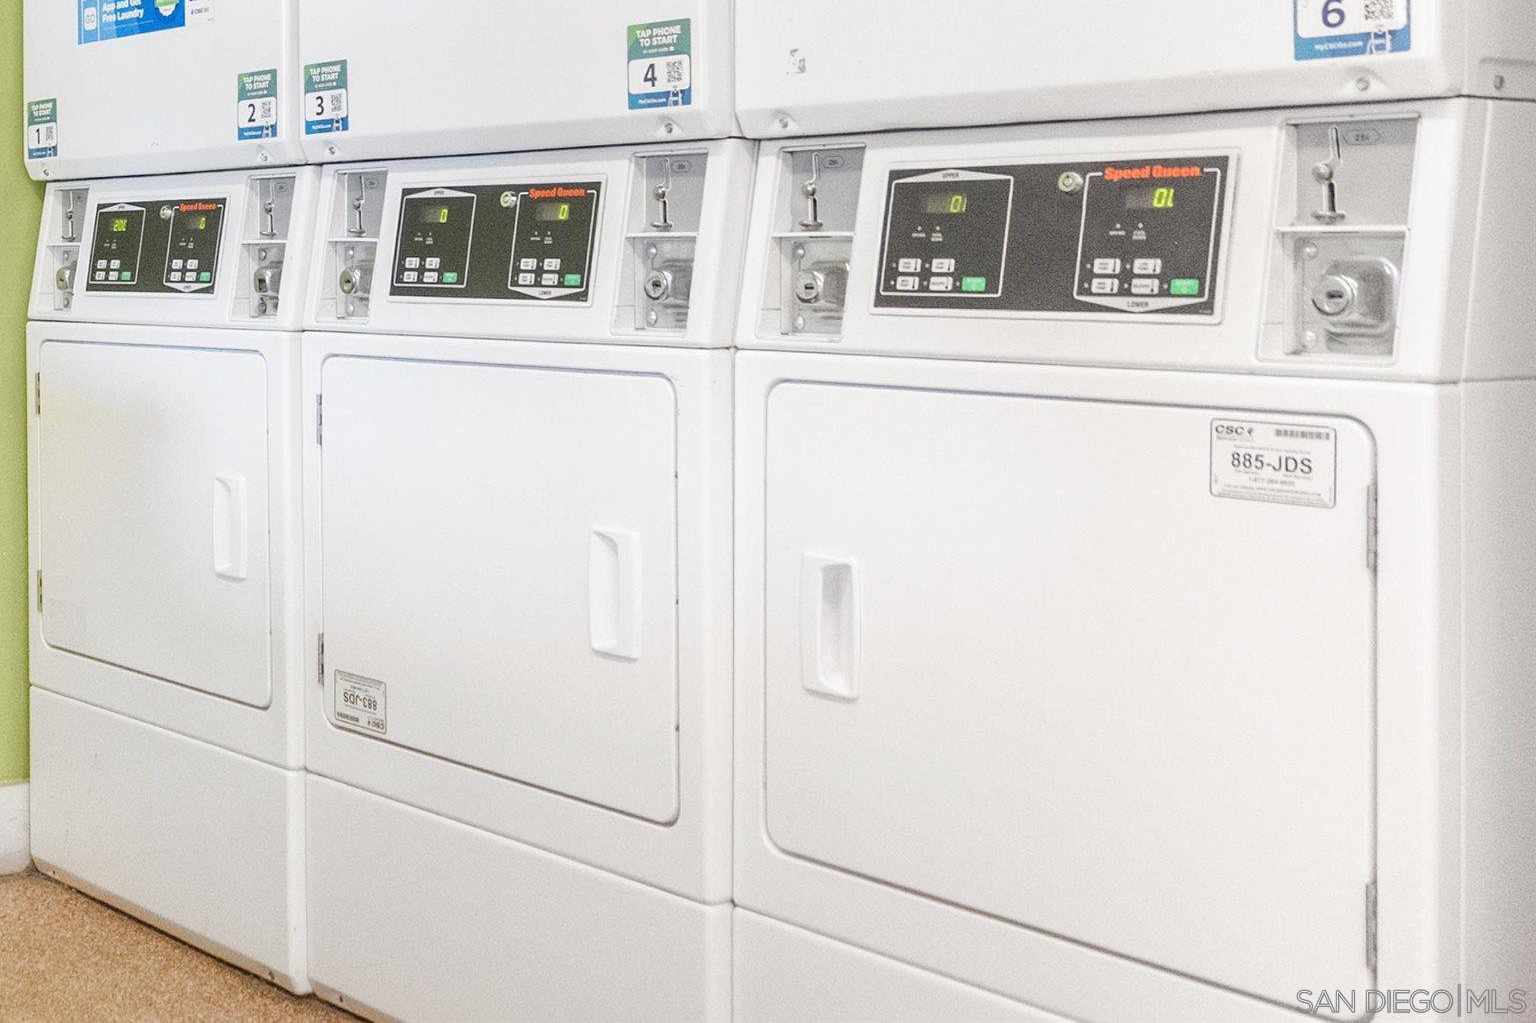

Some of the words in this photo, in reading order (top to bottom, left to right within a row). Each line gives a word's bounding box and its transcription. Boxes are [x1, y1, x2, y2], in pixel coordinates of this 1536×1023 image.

[103, 2, 116, 12] App
[117, 8, 144, 20] Laundry
[636, 29, 652, 38] TAP
[652, 25, 682, 37] PHONE
[639, 38, 651, 47] TO
[652, 34, 678, 45] START
[643, 63, 657, 87] 4
[248, 103, 256, 123] 2
[316, 96, 324, 116] 3
[35, 128, 41, 144] 1
[1104, 166, 1151, 181] Speed
[1152, 165, 1201, 178] Queen
[528, 187, 556, 199] Speed
[557, 187, 585, 197] Queen
[438, 208, 449, 223] 0
[1215, 424, 1245, 437] CSC
[1231, 452, 1313, 475] 885-JDS
